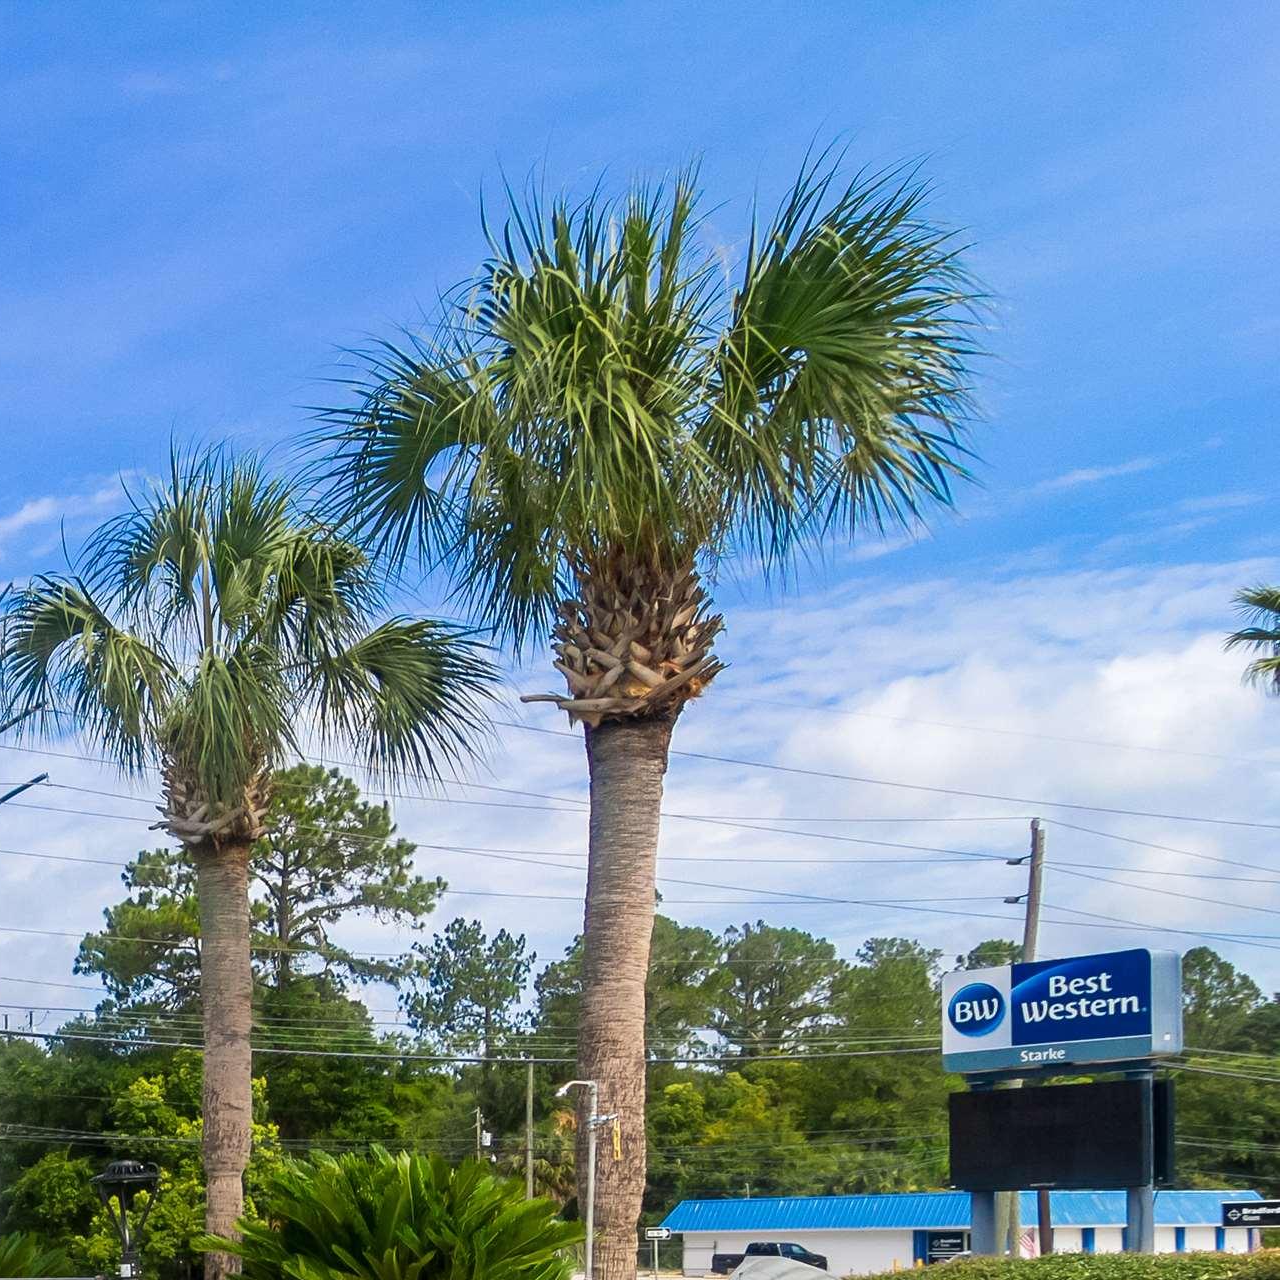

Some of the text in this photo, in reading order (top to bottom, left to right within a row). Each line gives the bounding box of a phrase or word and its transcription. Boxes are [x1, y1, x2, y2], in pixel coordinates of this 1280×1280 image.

[1048, 972, 1113, 997] Best
[955, 998, 999, 1023] BW
[1021, 995, 1140, 1024] Western
[1020, 1048, 1066, 1062] Starke
